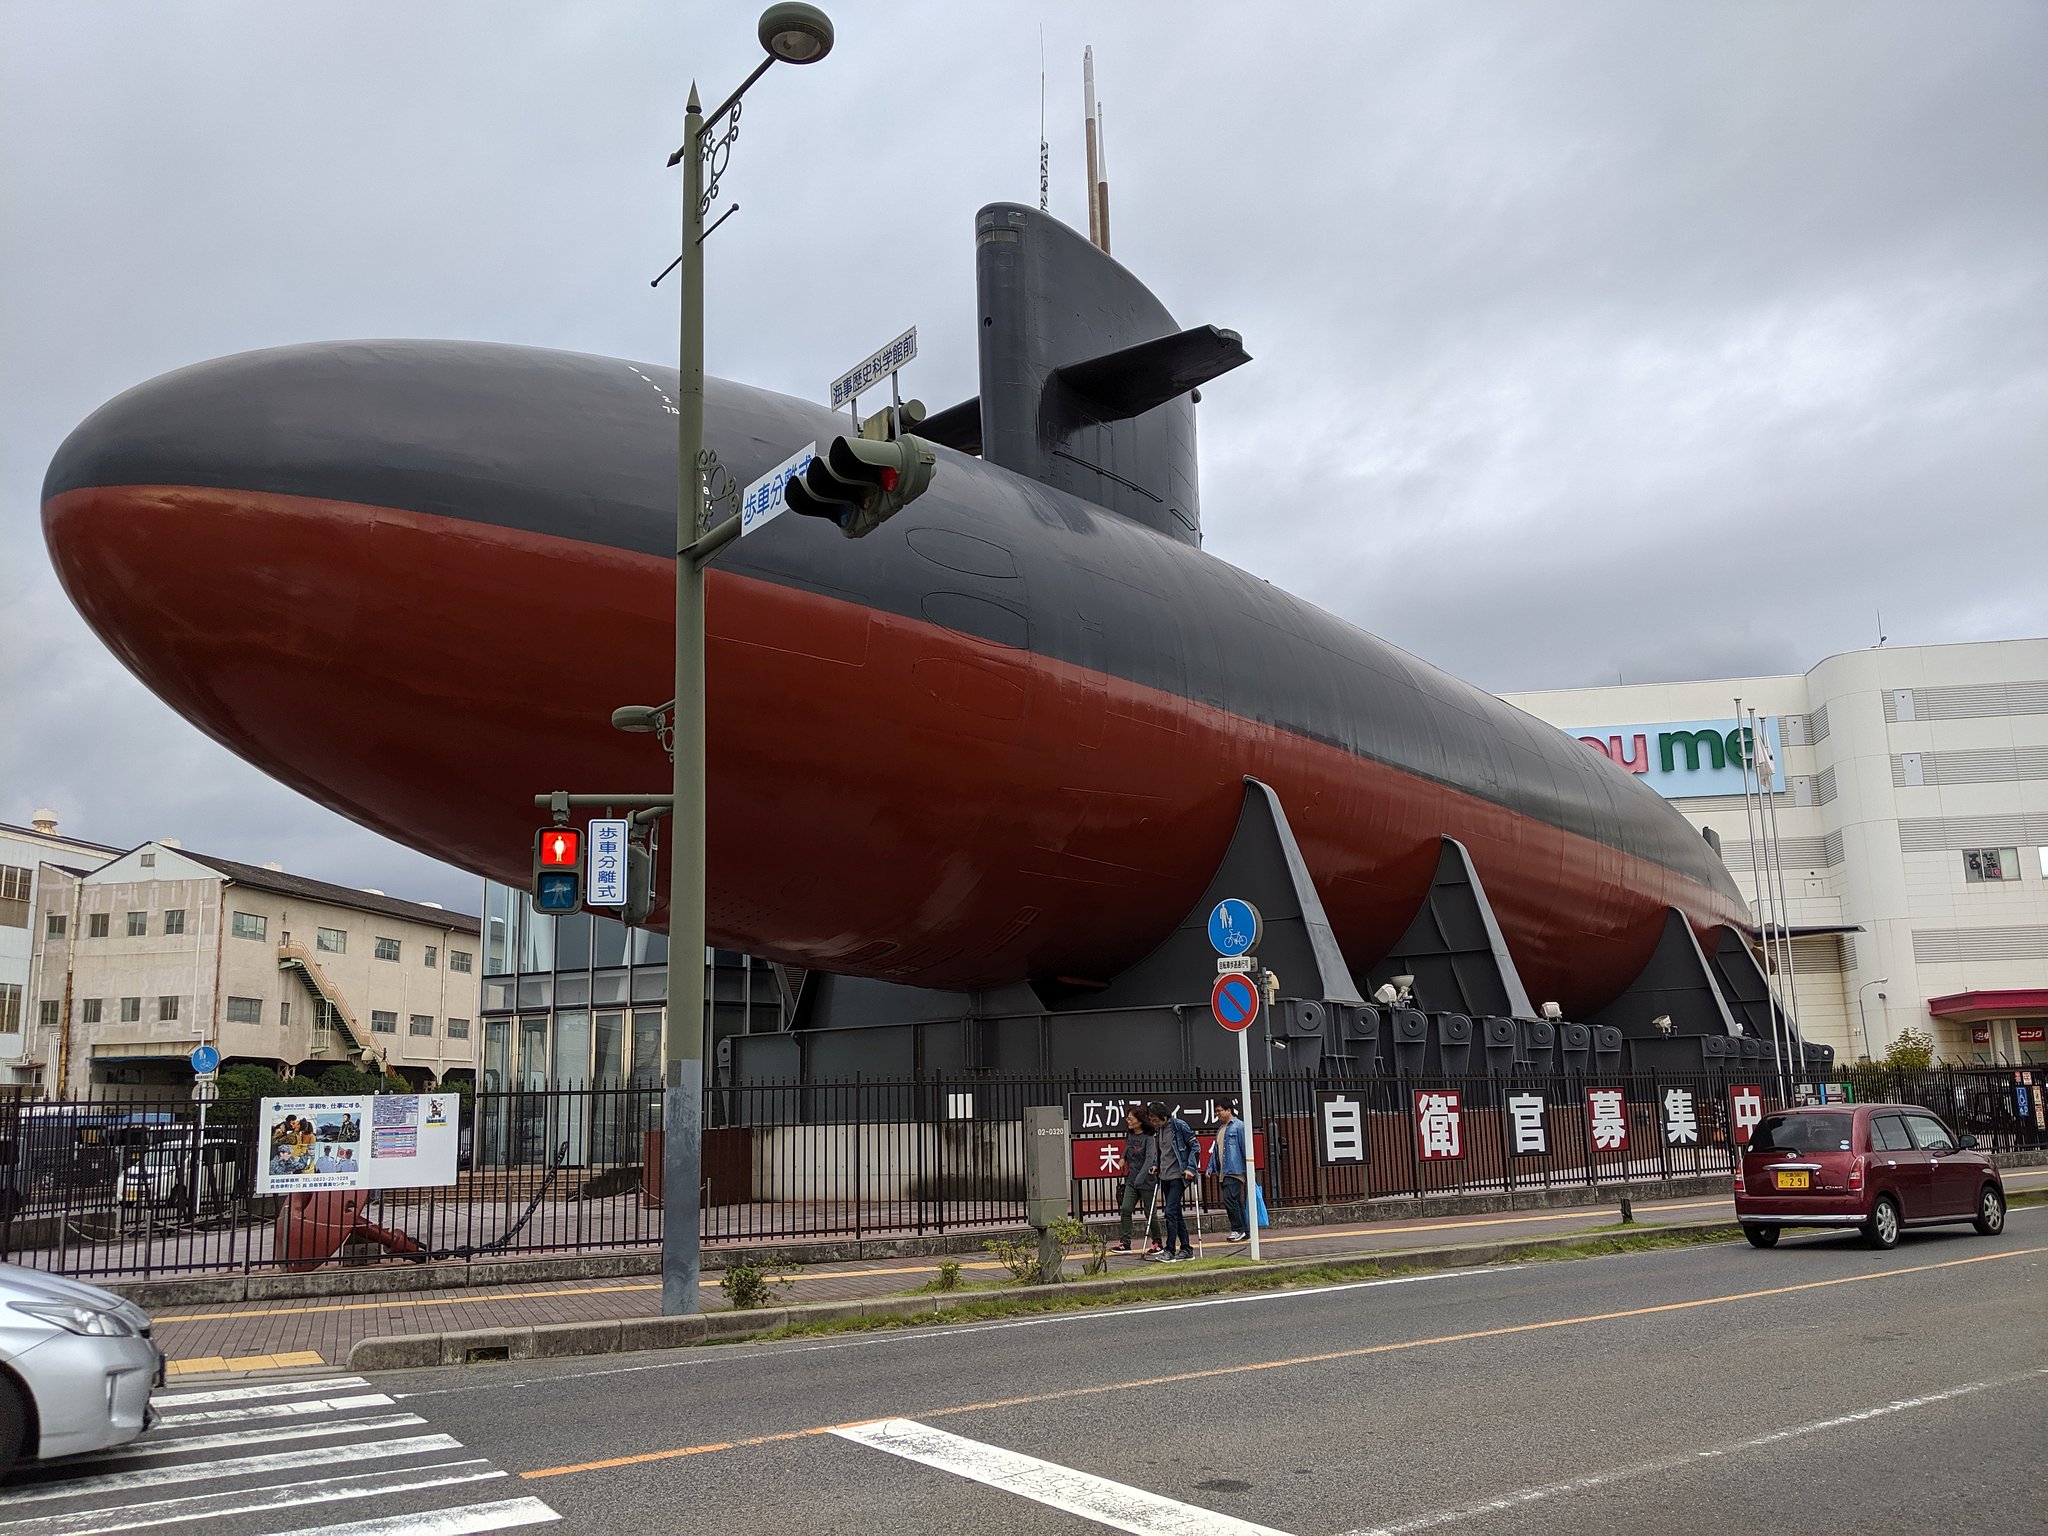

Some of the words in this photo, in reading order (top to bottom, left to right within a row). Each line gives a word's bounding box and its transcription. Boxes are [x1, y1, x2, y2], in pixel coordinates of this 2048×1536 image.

[832, 334, 914, 405] 海事歴史科学館前
[597, 827, 618, 898] 歩車分離式
[1037, 1127, 1064, 1136] 02-0320
